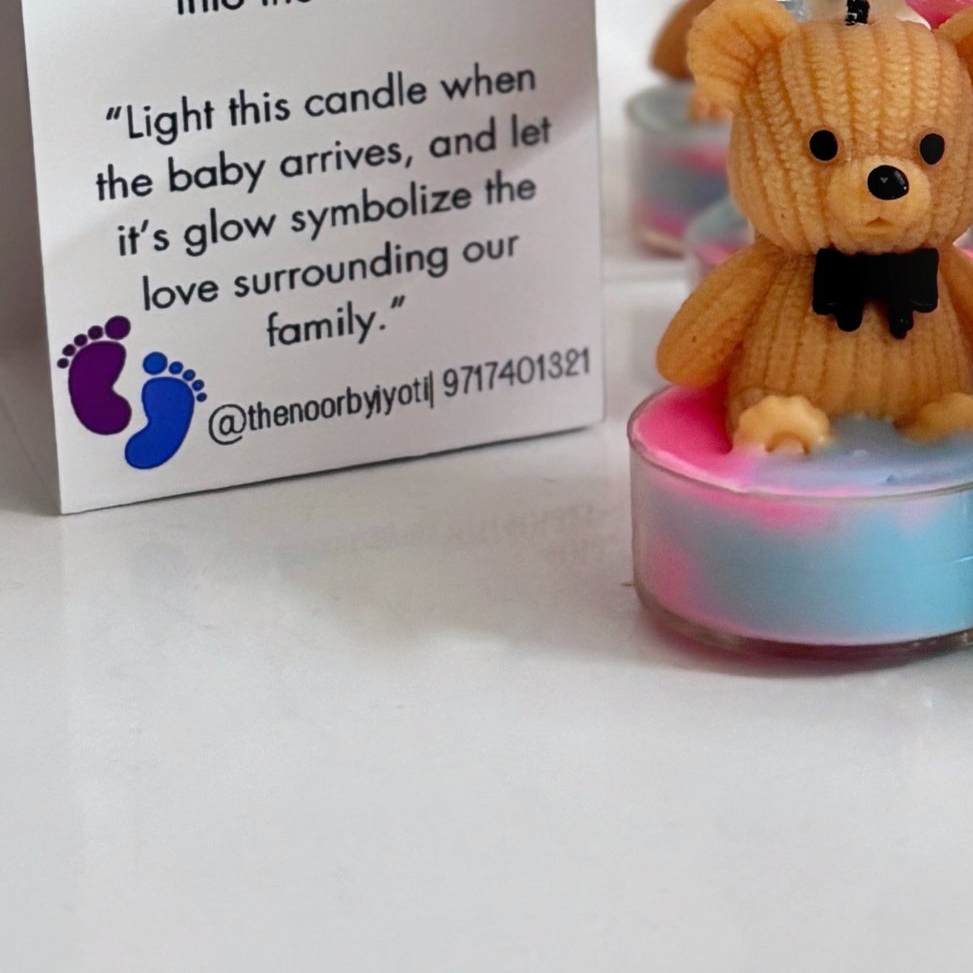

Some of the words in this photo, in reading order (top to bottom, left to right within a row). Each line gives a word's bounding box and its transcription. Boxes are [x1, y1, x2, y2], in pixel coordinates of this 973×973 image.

[106, 96, 214, 145] “Light
[229, 89, 290, 126] this
[304, 71, 426, 117] candle
[440, 62, 535, 99] when
[96, 164, 153, 201] the
[168, 150, 266, 193] baby
[280, 139, 412, 177] arrives,
[429, 117, 496, 158] and
[512, 114, 551, 147] let
[118, 219, 169, 257] it’s
[184, 208, 276, 257] glow
[291, 181, 471, 241] symbolize
[485, 170, 536, 204] the
[143, 276, 219, 311] love
[234, 241, 448, 297] surrounding
[463, 236, 519, 263] our
[267, 295, 405, 347] family.”
[443, 348, 589, 397] 9717401321
